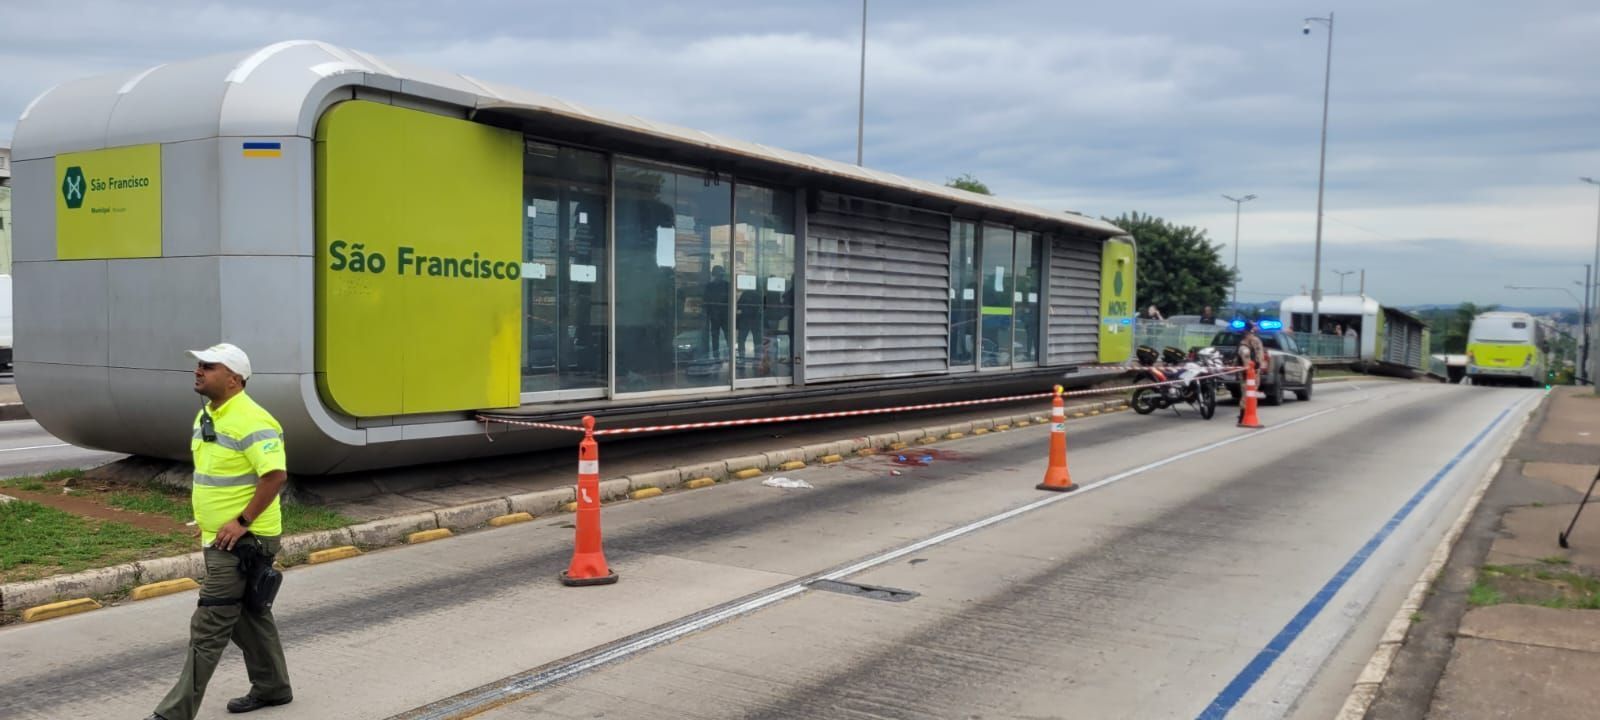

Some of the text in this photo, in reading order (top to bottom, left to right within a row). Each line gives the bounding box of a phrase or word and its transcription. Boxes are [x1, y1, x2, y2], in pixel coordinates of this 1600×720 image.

[90, 175, 149, 192] São Francisco
[329, 240, 521, 281] São Francisco
[1108, 301, 1127, 316] MOVE
